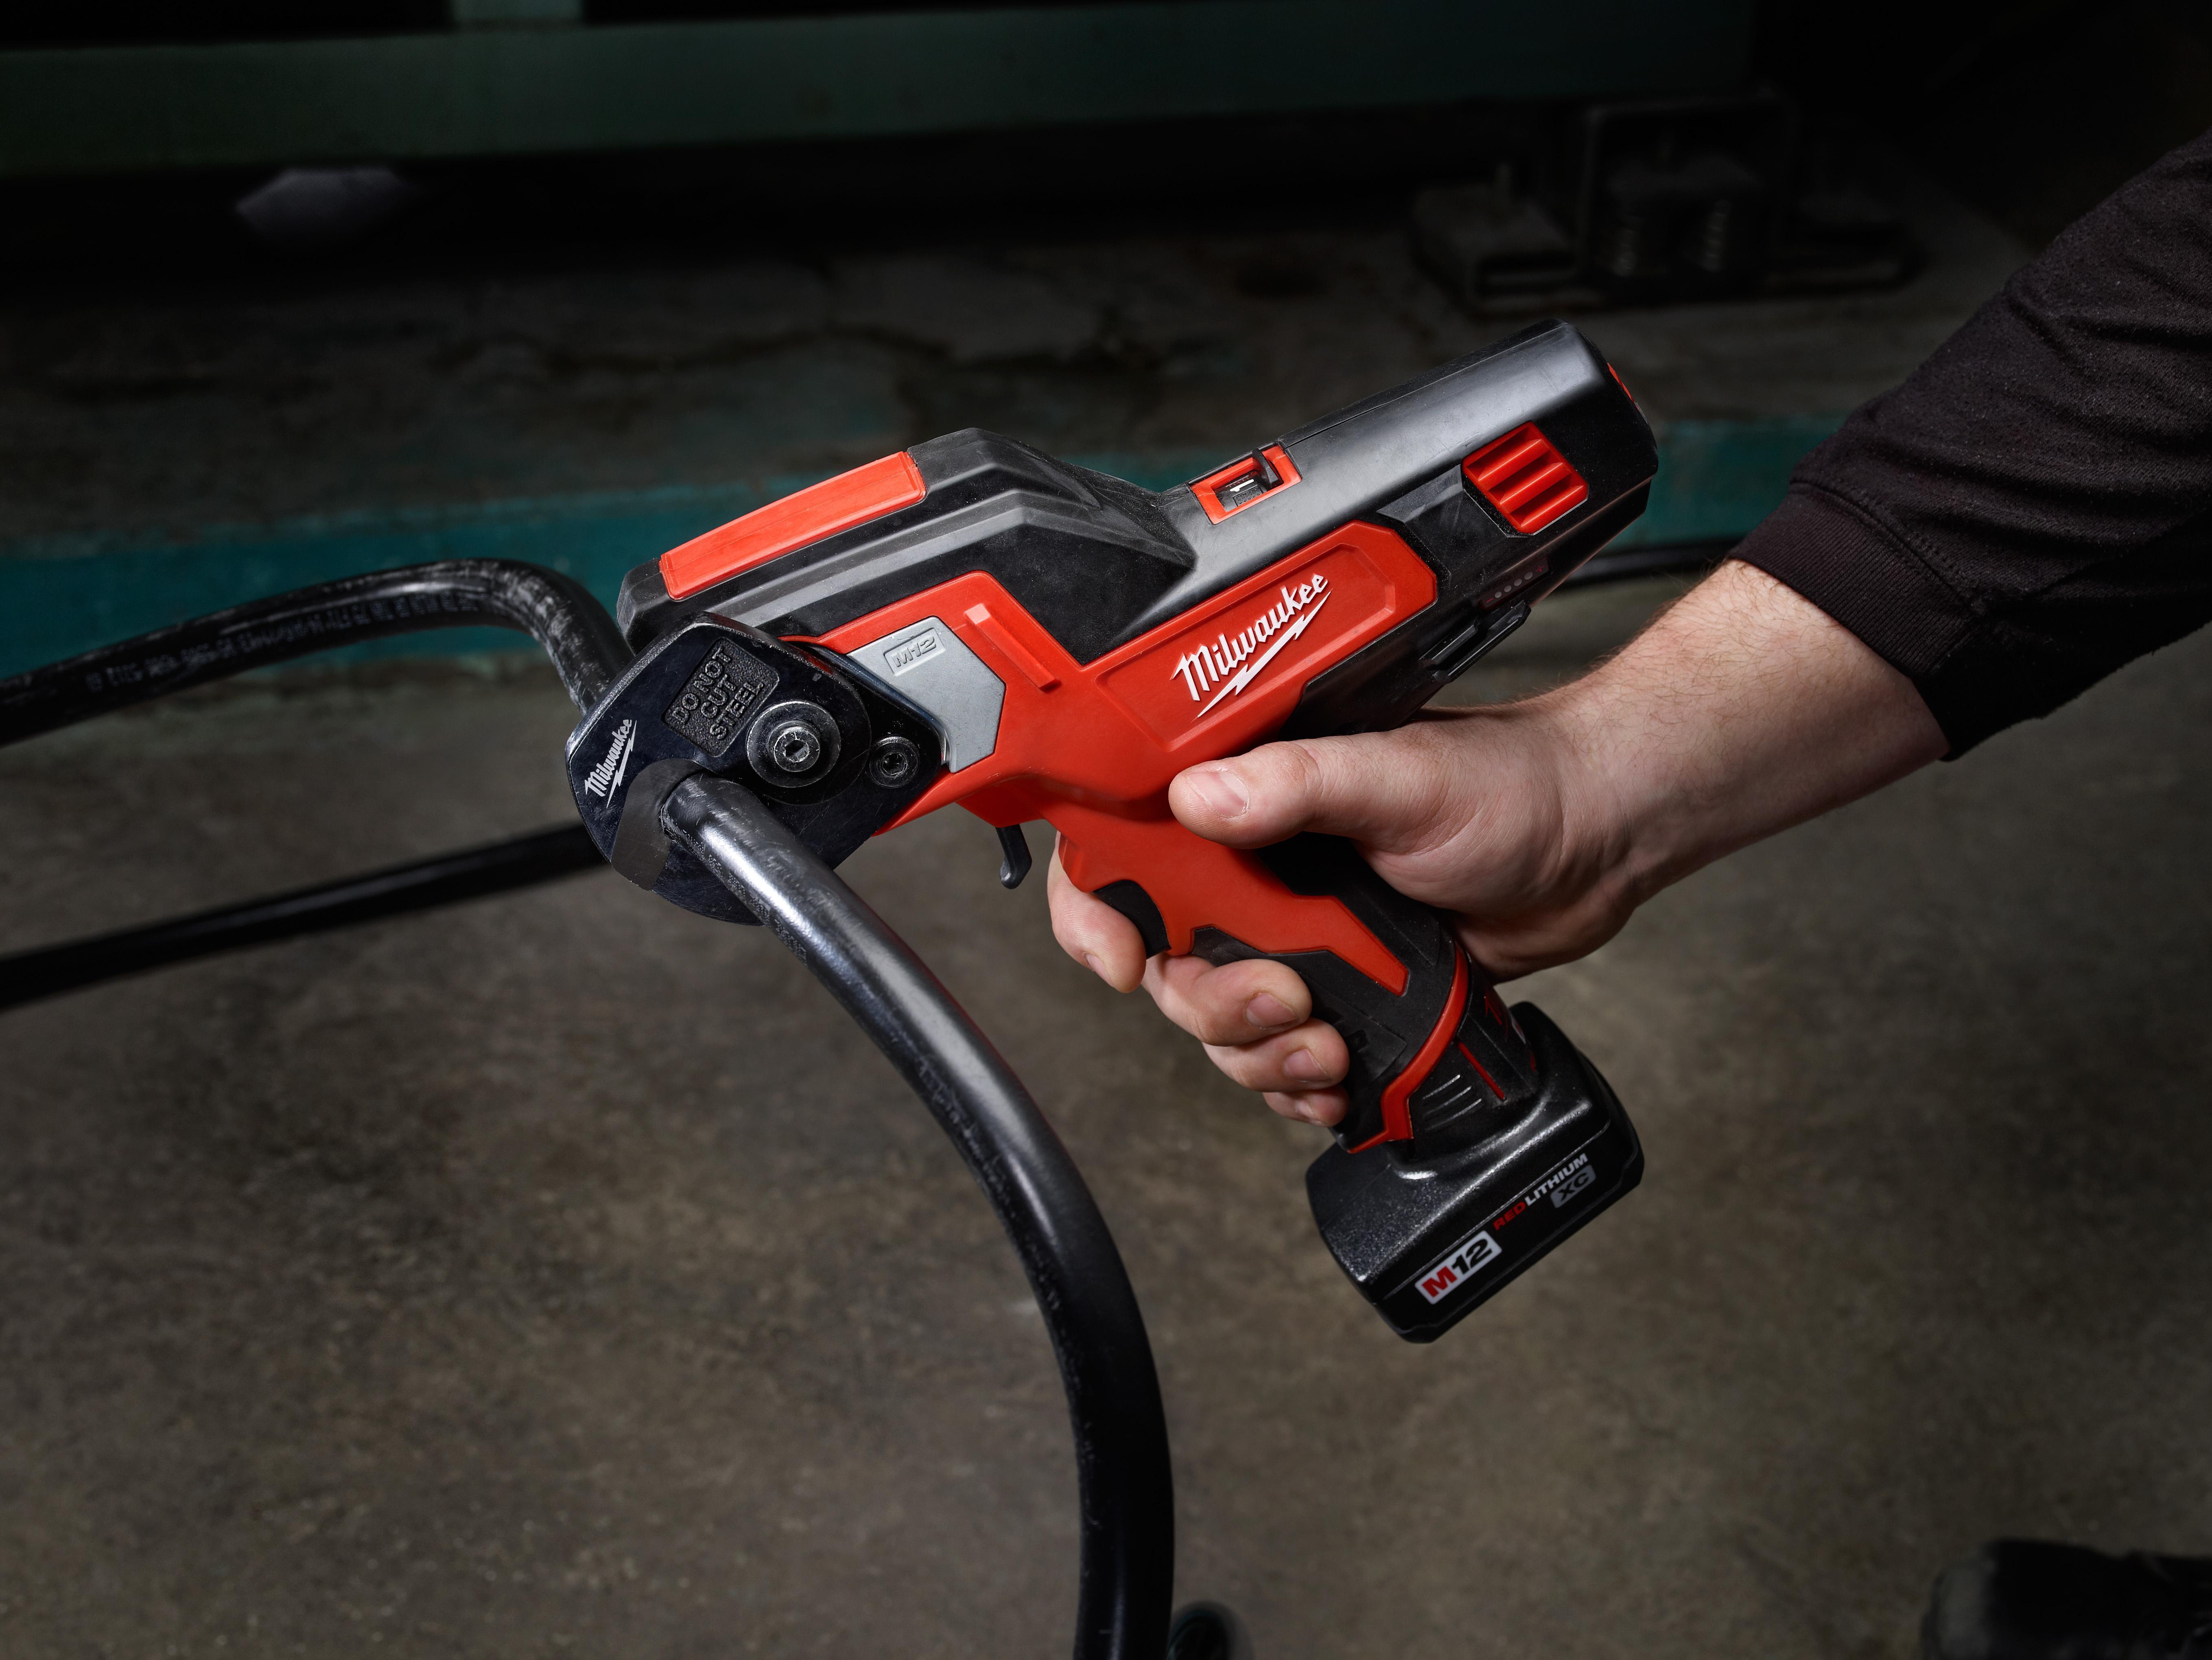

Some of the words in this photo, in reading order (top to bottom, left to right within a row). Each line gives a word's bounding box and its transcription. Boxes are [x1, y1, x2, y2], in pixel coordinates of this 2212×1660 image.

[891, 636, 937, 667] M12
[1170, 574, 1328, 701] Milwaukee
[671, 692, 700, 724] DO
[693, 646, 732, 692] NOT
[700, 673, 737, 719] CUT
[710, 681, 765, 740] STEEL
[584, 719, 632, 797] Milwaukee
[1558, 1173, 1589, 1201] XC
[1421, 1238, 1493, 1298] M12
